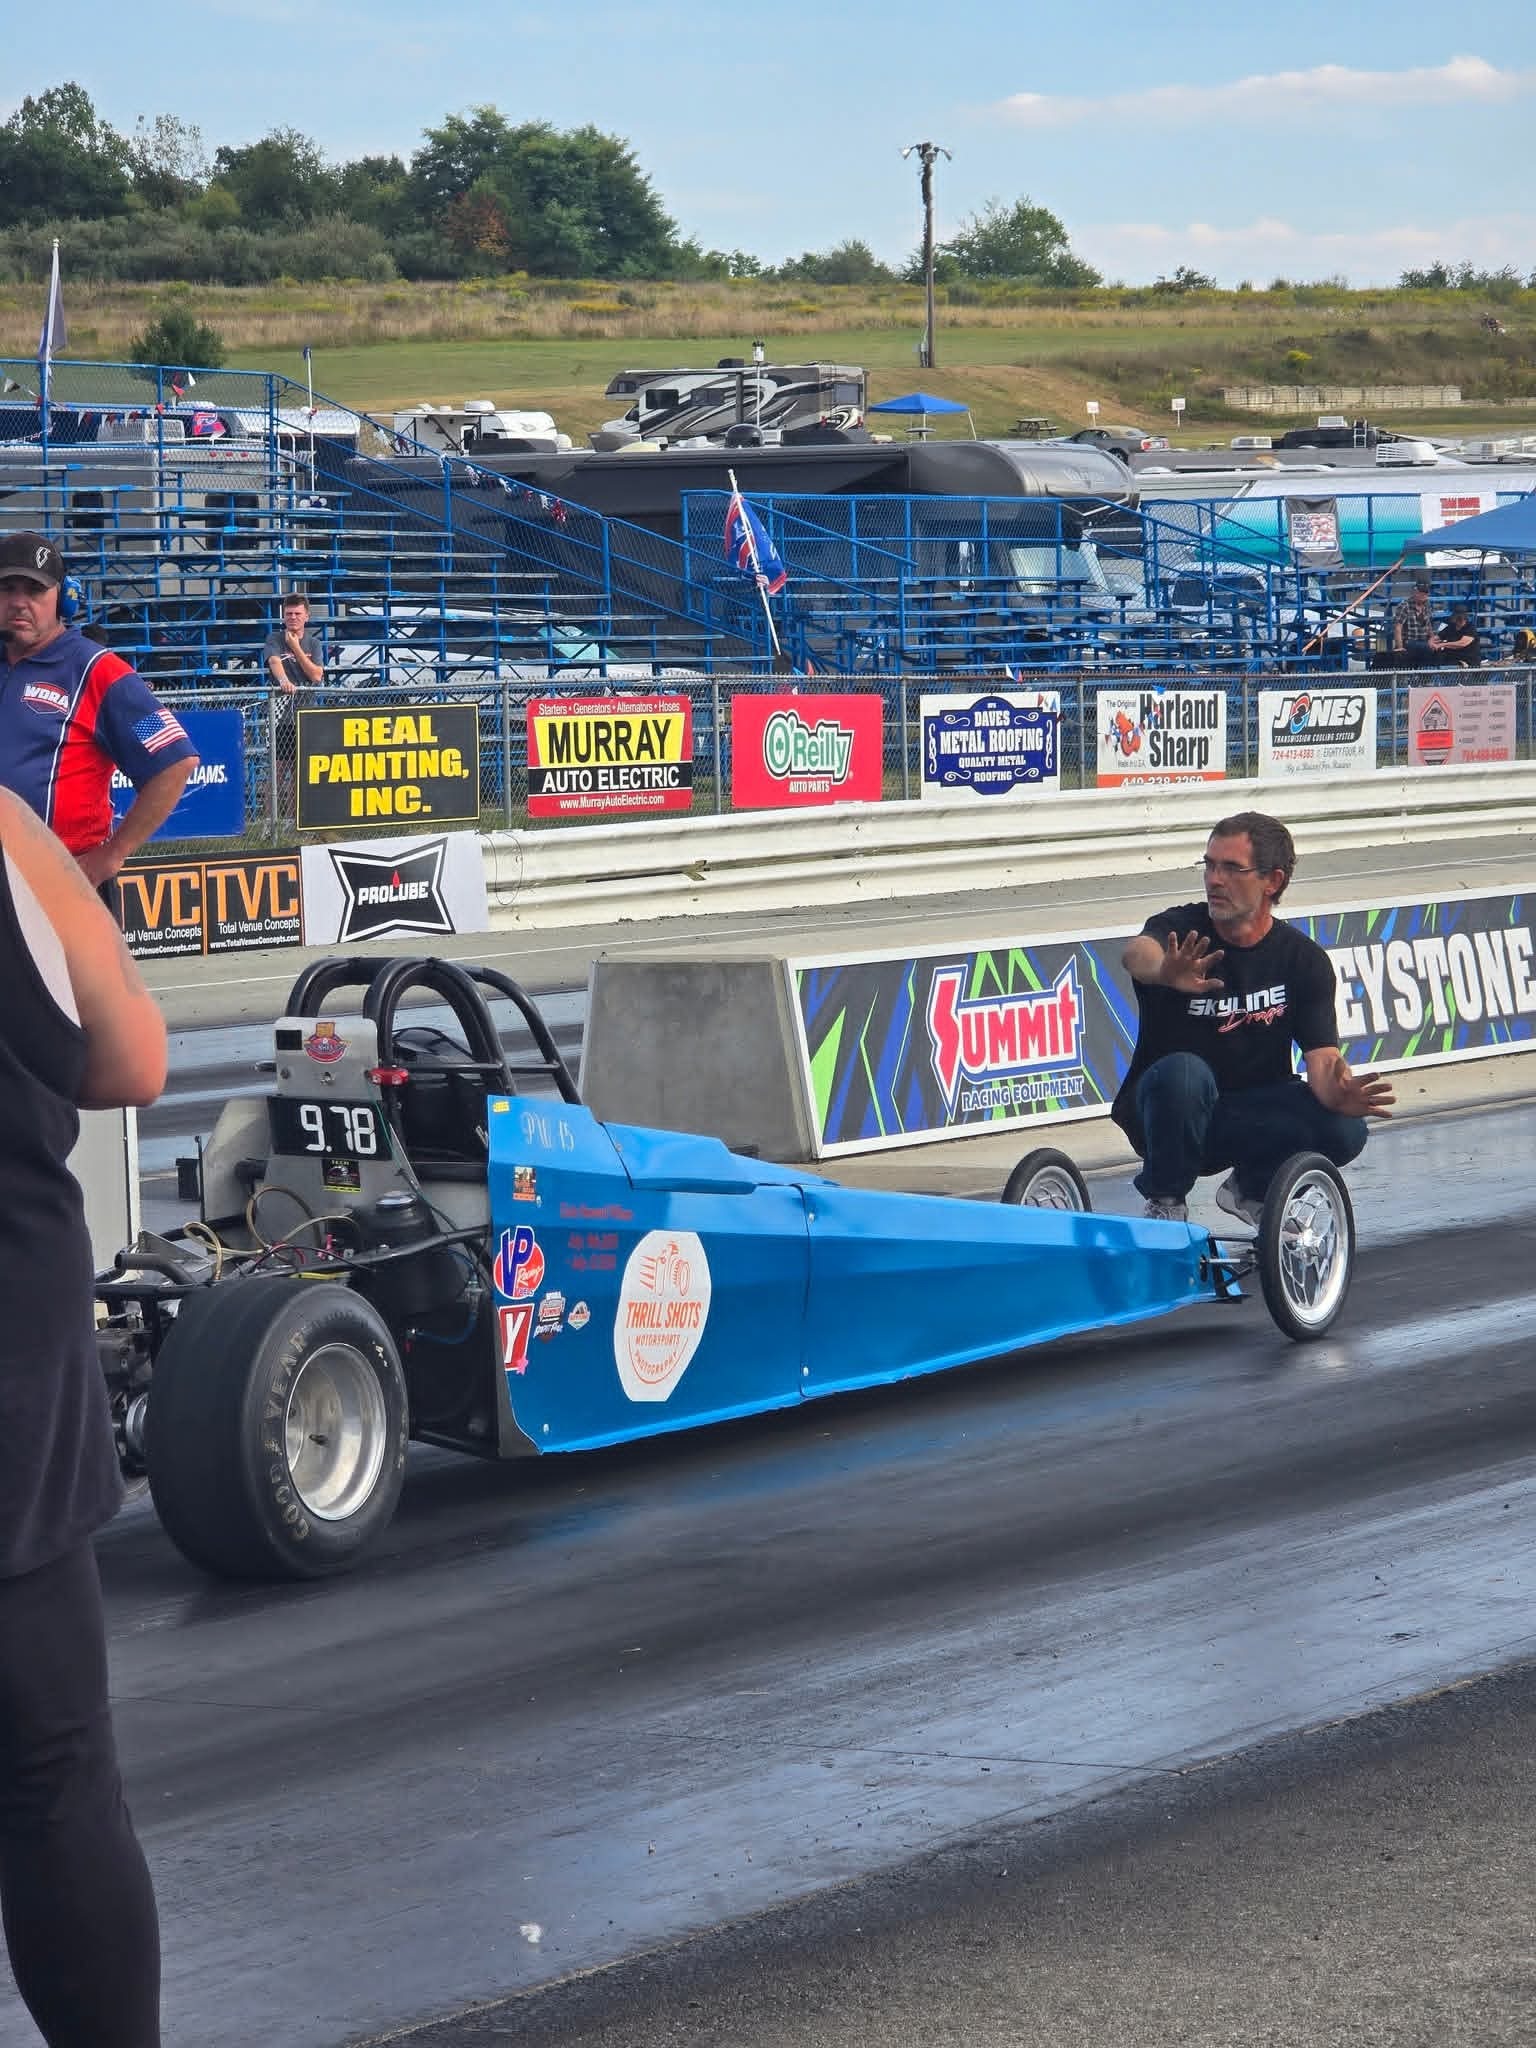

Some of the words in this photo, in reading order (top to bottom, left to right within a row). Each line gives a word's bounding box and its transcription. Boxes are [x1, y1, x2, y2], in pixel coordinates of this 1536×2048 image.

[539, 703, 567, 716] Starters
[573, 703, 611, 714] Generators
[617, 701, 652, 713] Alternators
[658, 701, 680, 712] Hoses
[974, 711, 1010, 727] DAVES
[1140, 694, 1218, 729] Harland
[1273, 694, 1364, 732] JONES
[343, 715, 438, 747] REAL
[548, 719, 671, 764] MURRAY
[940, 730, 985, 754] METAL
[989, 728, 1043, 752] ROOFING
[1274, 735, 1311, 744] TRANSMISSION
[1312, 733, 1335, 742] COOLING
[1335, 732, 1355, 741] SYSTEM
[766, 714, 850, 780] O'Reilly
[959, 756, 995, 768] QUALITY
[998, 755, 1026, 766] METAL
[1149, 731, 1209, 769] Sharp
[309, 748, 470, 784] PAINTING,
[542, 770, 592, 793] AUTO
[598, 766, 679, 790] ELECTRIC
[974, 771, 1012, 782] ROOFING
[351, 785, 432, 817] INC.
[560, 794, 664, 809] www.MurrayAutoElectric.com
[789, 781, 807, 793] AUTO
[808, 781, 830, 792] PARTS
[207, 864, 299, 922] TVC
[358, 880, 429, 905] PROLUBE
[138, 929, 163, 942] Venue
[165, 925, 202, 940] Concepts
[218, 922, 237, 935] Total
[238, 920, 262, 933] Venue
[264, 917, 300, 931] Concepts
[210, 935, 299, 949] www.TotalVenueConcepts.com
[1325, 927, 1536, 1038] EYSTONE
[1188, 984, 1286, 1017] SKYLINE
[930, 969, 1079, 1092] SUMMIT
[962, 1088, 1011, 1112] RACING
[1013, 1075, 1084, 1103] EQUIPMENT
[300, 1104, 377, 1154] 9.78
[500, 1226, 535, 1298] VP
[626, 1301, 662, 1328] THRILL
[665, 1301, 702, 1328] SHOTS
[636, 1334, 681, 1347] MOTORSPORTS
